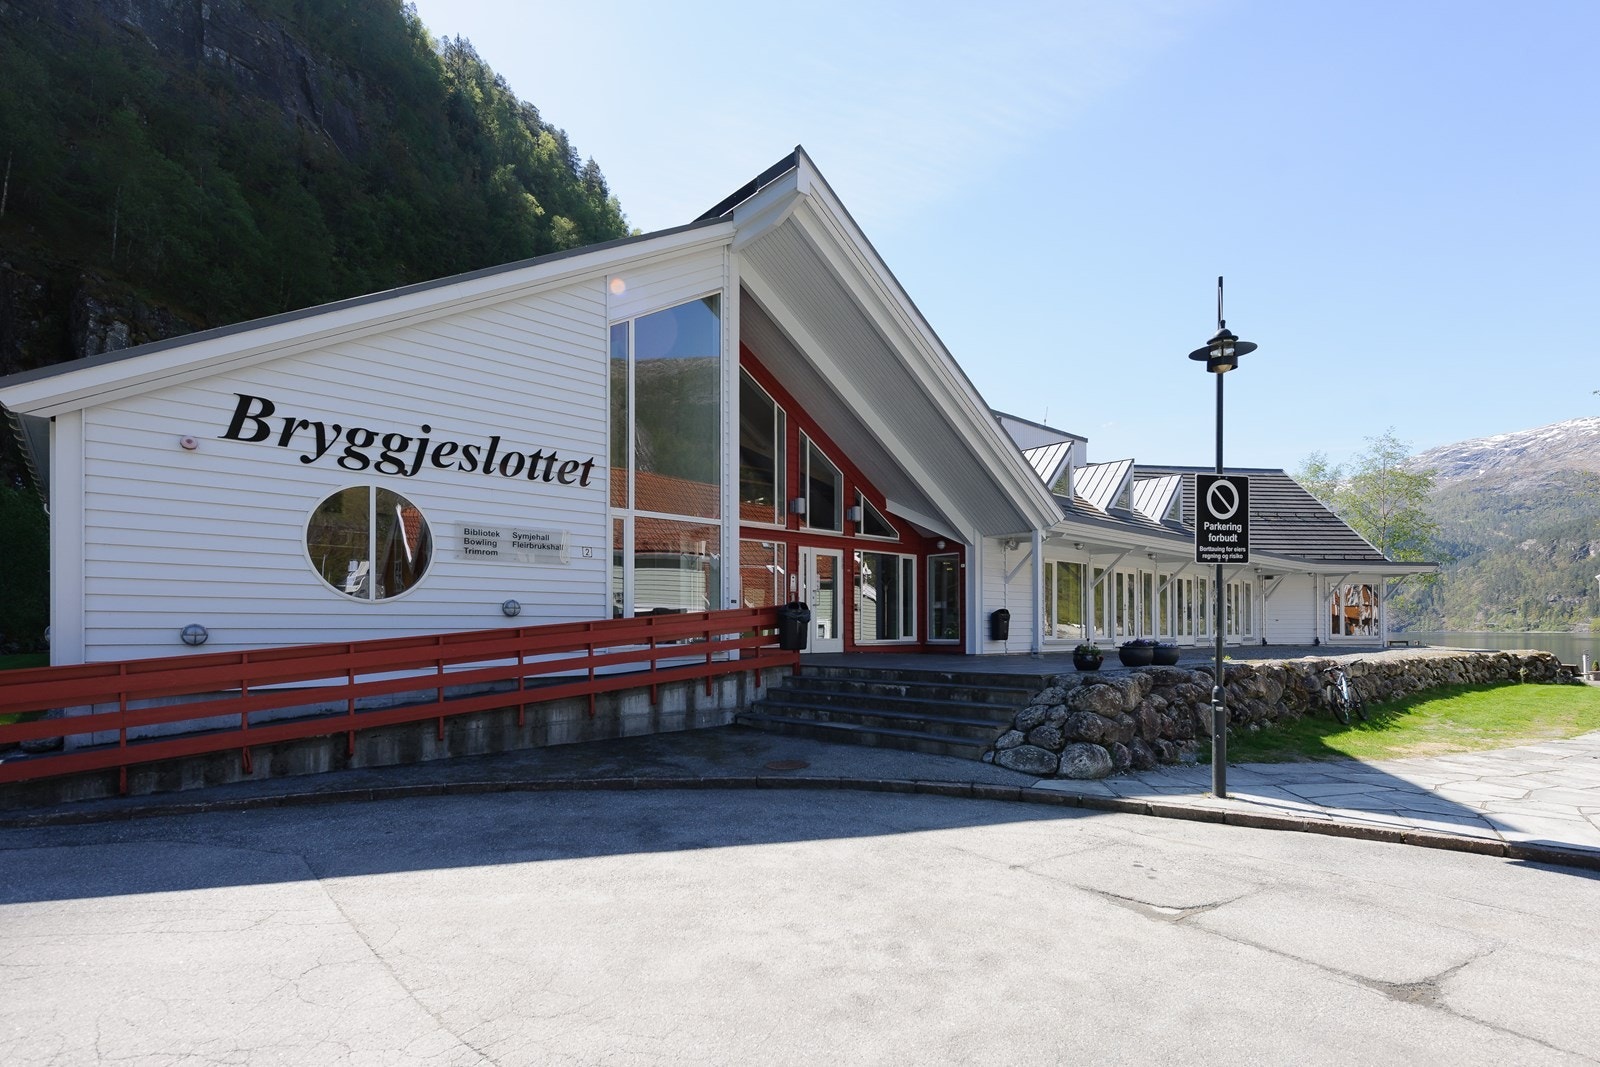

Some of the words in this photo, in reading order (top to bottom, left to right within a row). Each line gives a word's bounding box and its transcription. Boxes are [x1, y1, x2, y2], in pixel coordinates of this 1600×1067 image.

[217, 392, 595, 487] Bryggjeslottet
[463, 527, 501, 538] Bibliotek
[1203, 522, 1242, 533] Parkering
[512, 531, 550, 541] Symjehall
[1208, 533, 1238, 542] forbudt
[463, 537, 498, 548] Bowling
[512, 541, 564, 551] Fleirbrukshall
[463, 547, 499, 556] Trimrom
